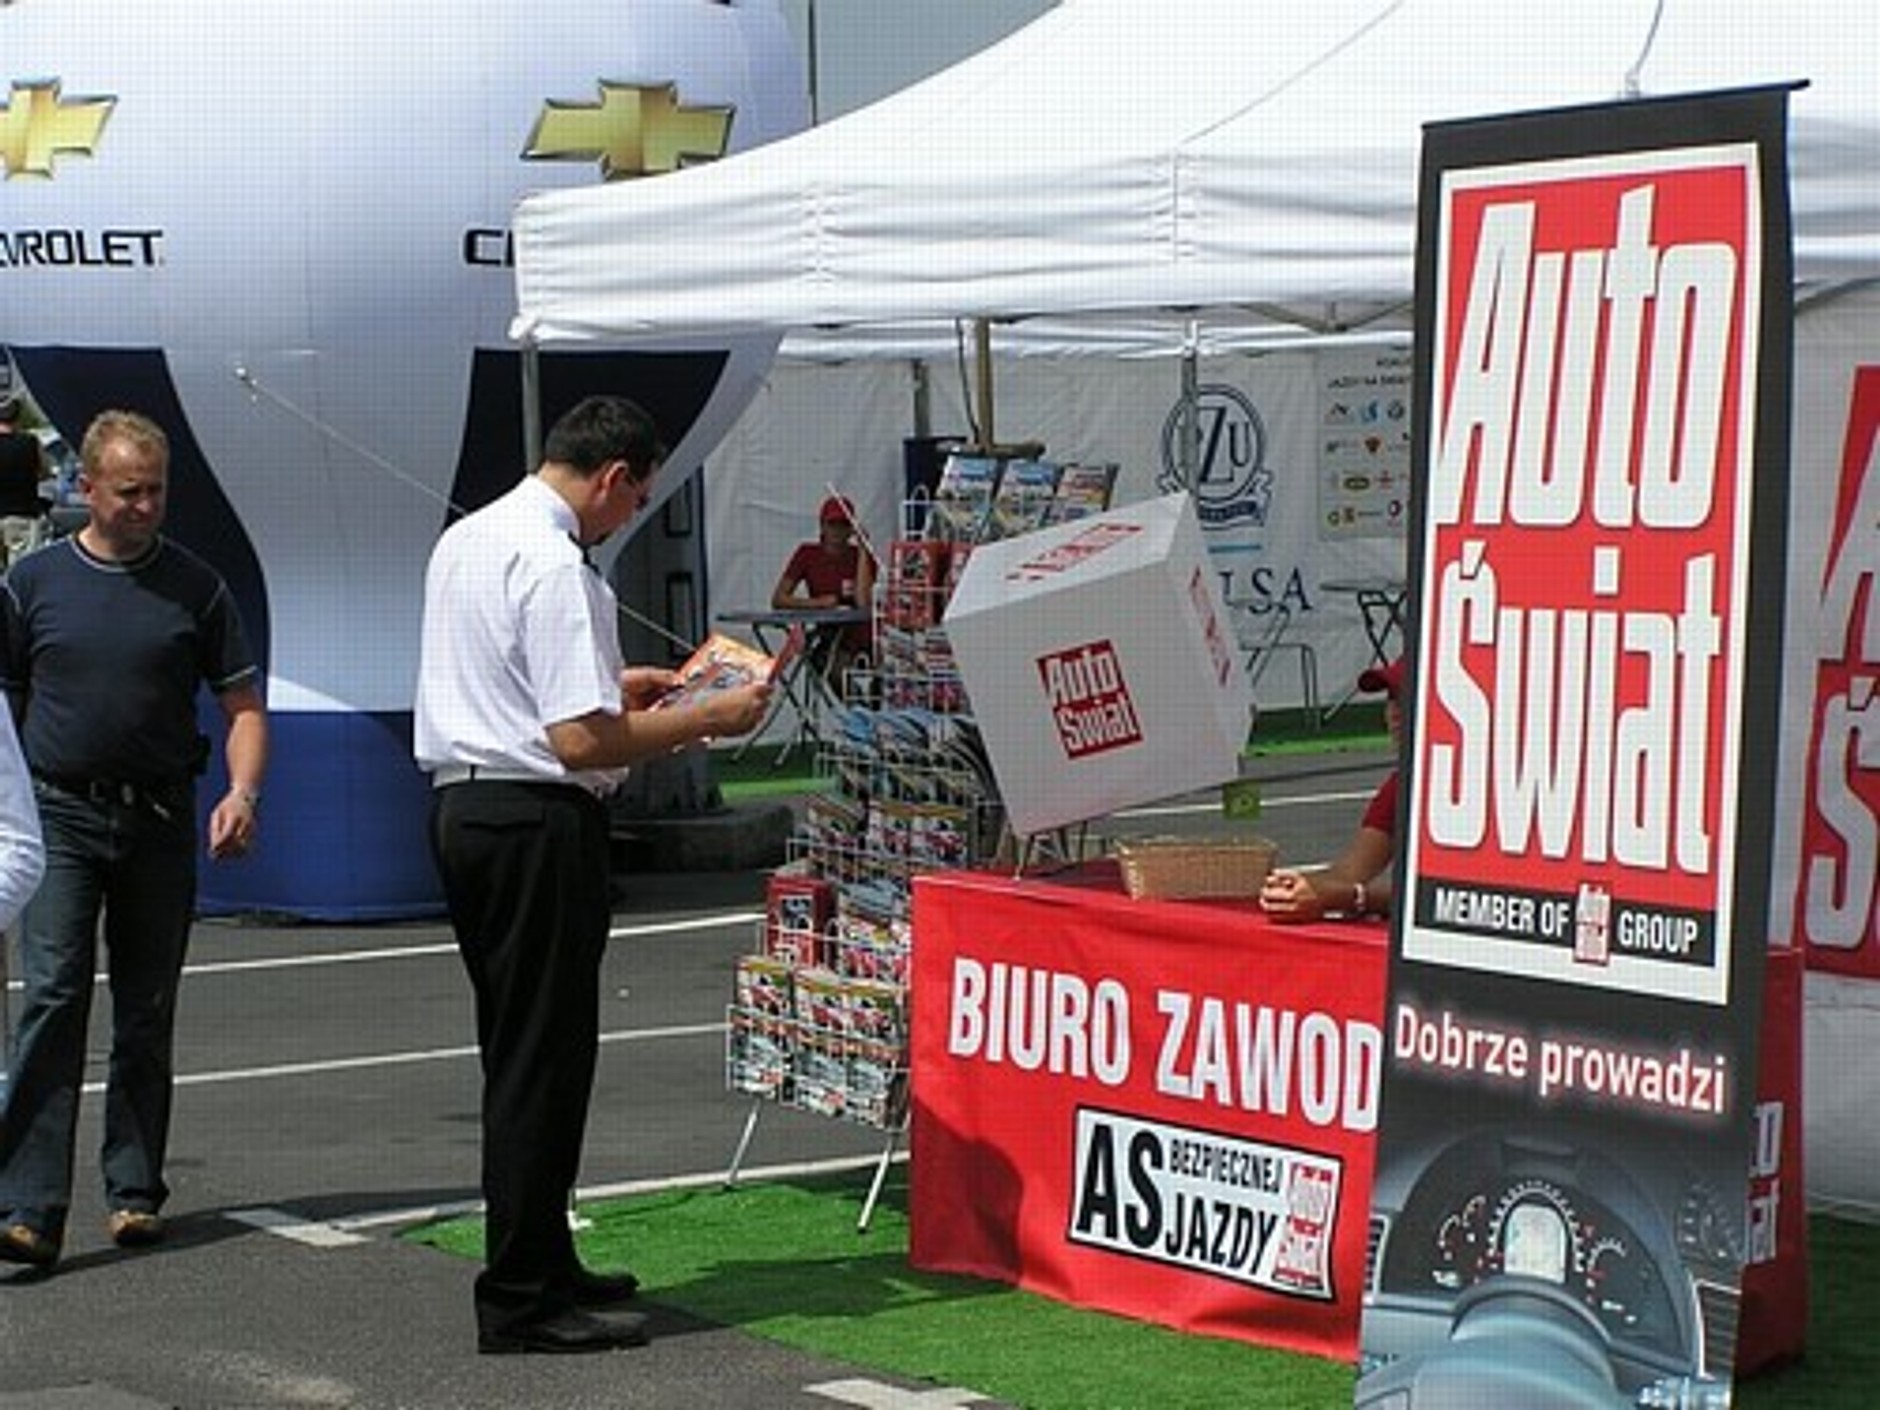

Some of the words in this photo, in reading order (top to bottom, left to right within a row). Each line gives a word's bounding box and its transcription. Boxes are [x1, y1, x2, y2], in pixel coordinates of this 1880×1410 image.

[0, 229, 163, 266] VROLET
[1434, 183, 1738, 527] Auto
[1045, 650, 1119, 704] Auto
[1428, 540, 1722, 873] Świat
[1433, 886, 1536, 933] MEMBER
[1540, 902, 1570, 937] OF
[1616, 910, 1699, 955] GROUP
[947, 957, 1131, 1086] BIURO
[1395, 1005, 1529, 1078] Dobrze
[1538, 1049, 1725, 1114] prowadzi
[1076, 1123, 1163, 1249] AS
[1169, 1138, 1284, 1195] BEZPIECZNEJ
[1166, 1192, 1278, 1276] JAZDY
